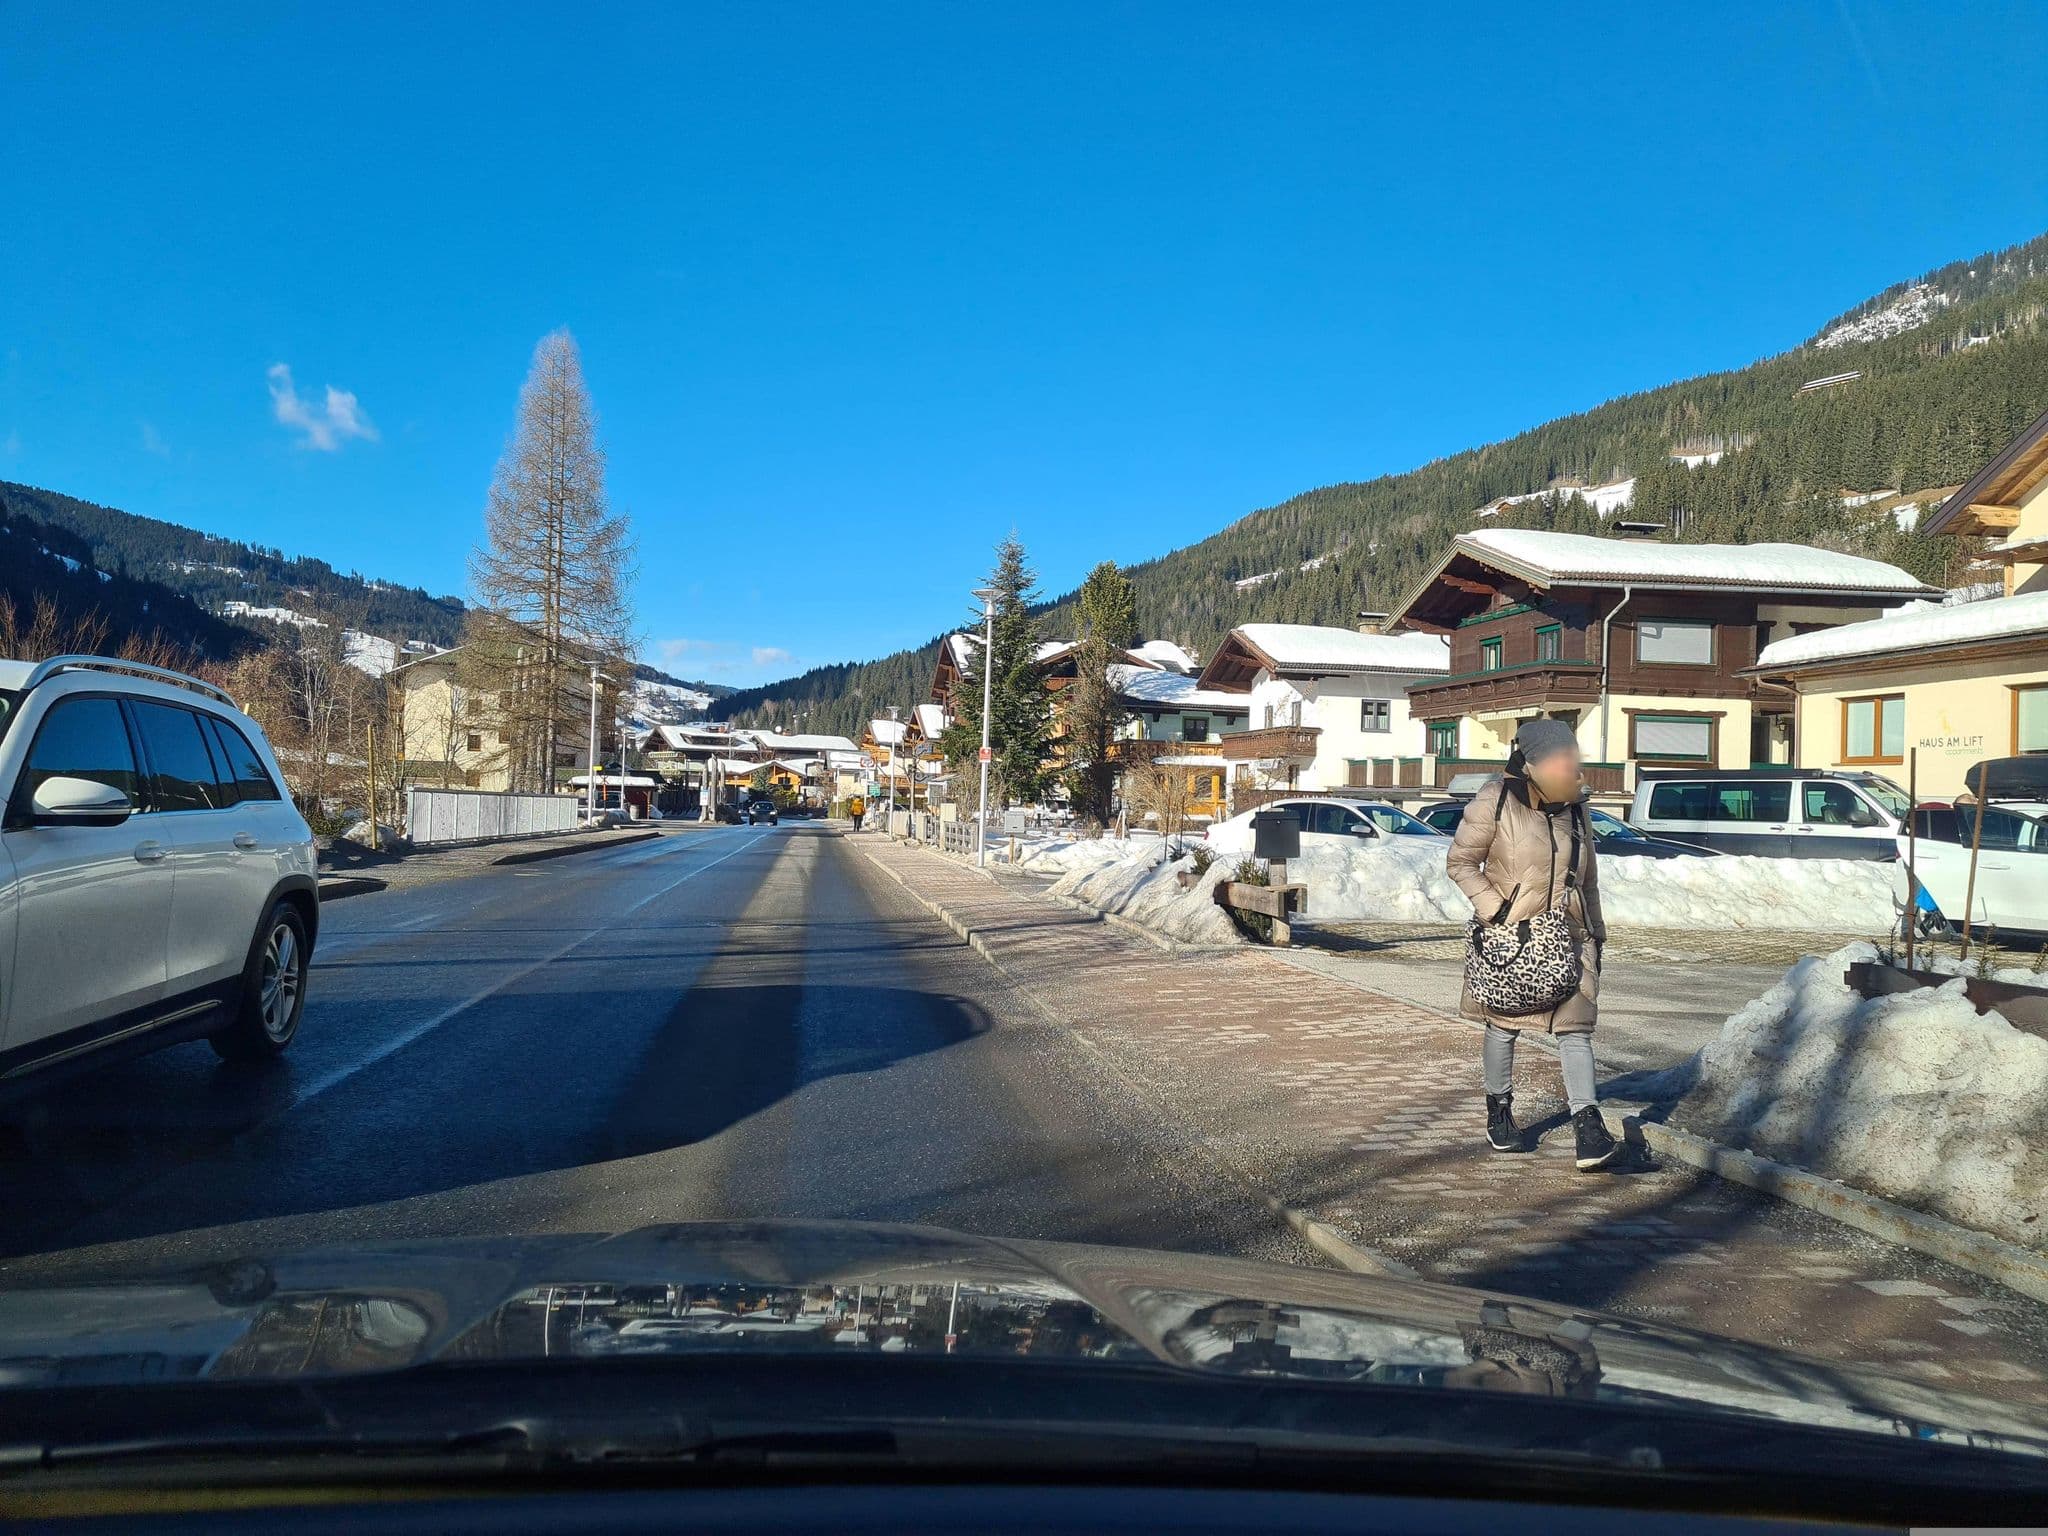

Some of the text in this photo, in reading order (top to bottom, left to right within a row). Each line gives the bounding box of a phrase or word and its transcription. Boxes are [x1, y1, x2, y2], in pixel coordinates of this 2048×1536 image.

[1919, 735, 1984, 748] HAUS AM LIFT
